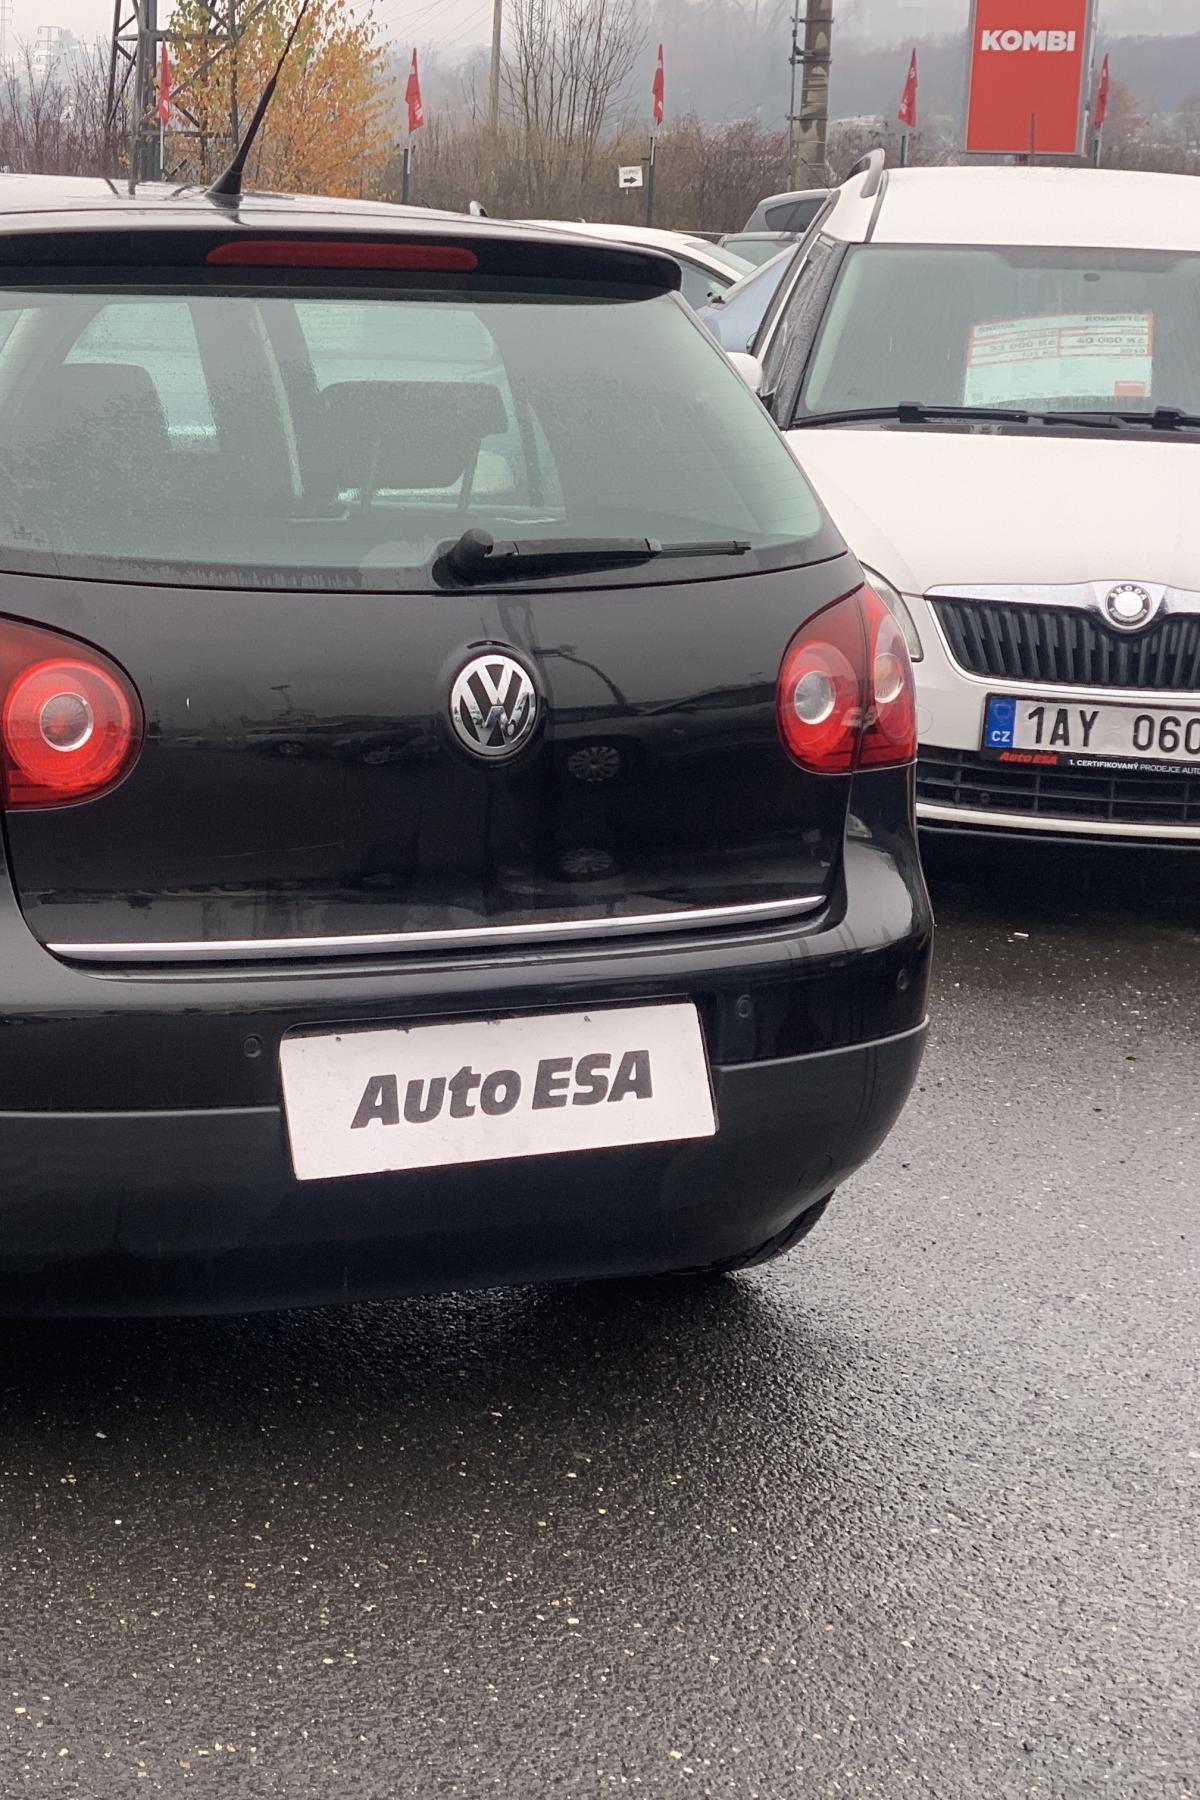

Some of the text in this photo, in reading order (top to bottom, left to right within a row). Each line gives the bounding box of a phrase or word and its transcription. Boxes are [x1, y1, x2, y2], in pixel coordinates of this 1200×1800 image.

[981, 30, 1076, 51] KOMBI
[992, 730, 1010, 742] CZ
[1028, 706, 1200, 755] 1AY 060
[999, 752, 1033, 763] Auto
[1076, 759, 1139, 771] CERTIFIKOVANÝ
[1140, 763, 1181, 774] PRODEJCE
[350, 1050, 653, 1129] Auto ESA
